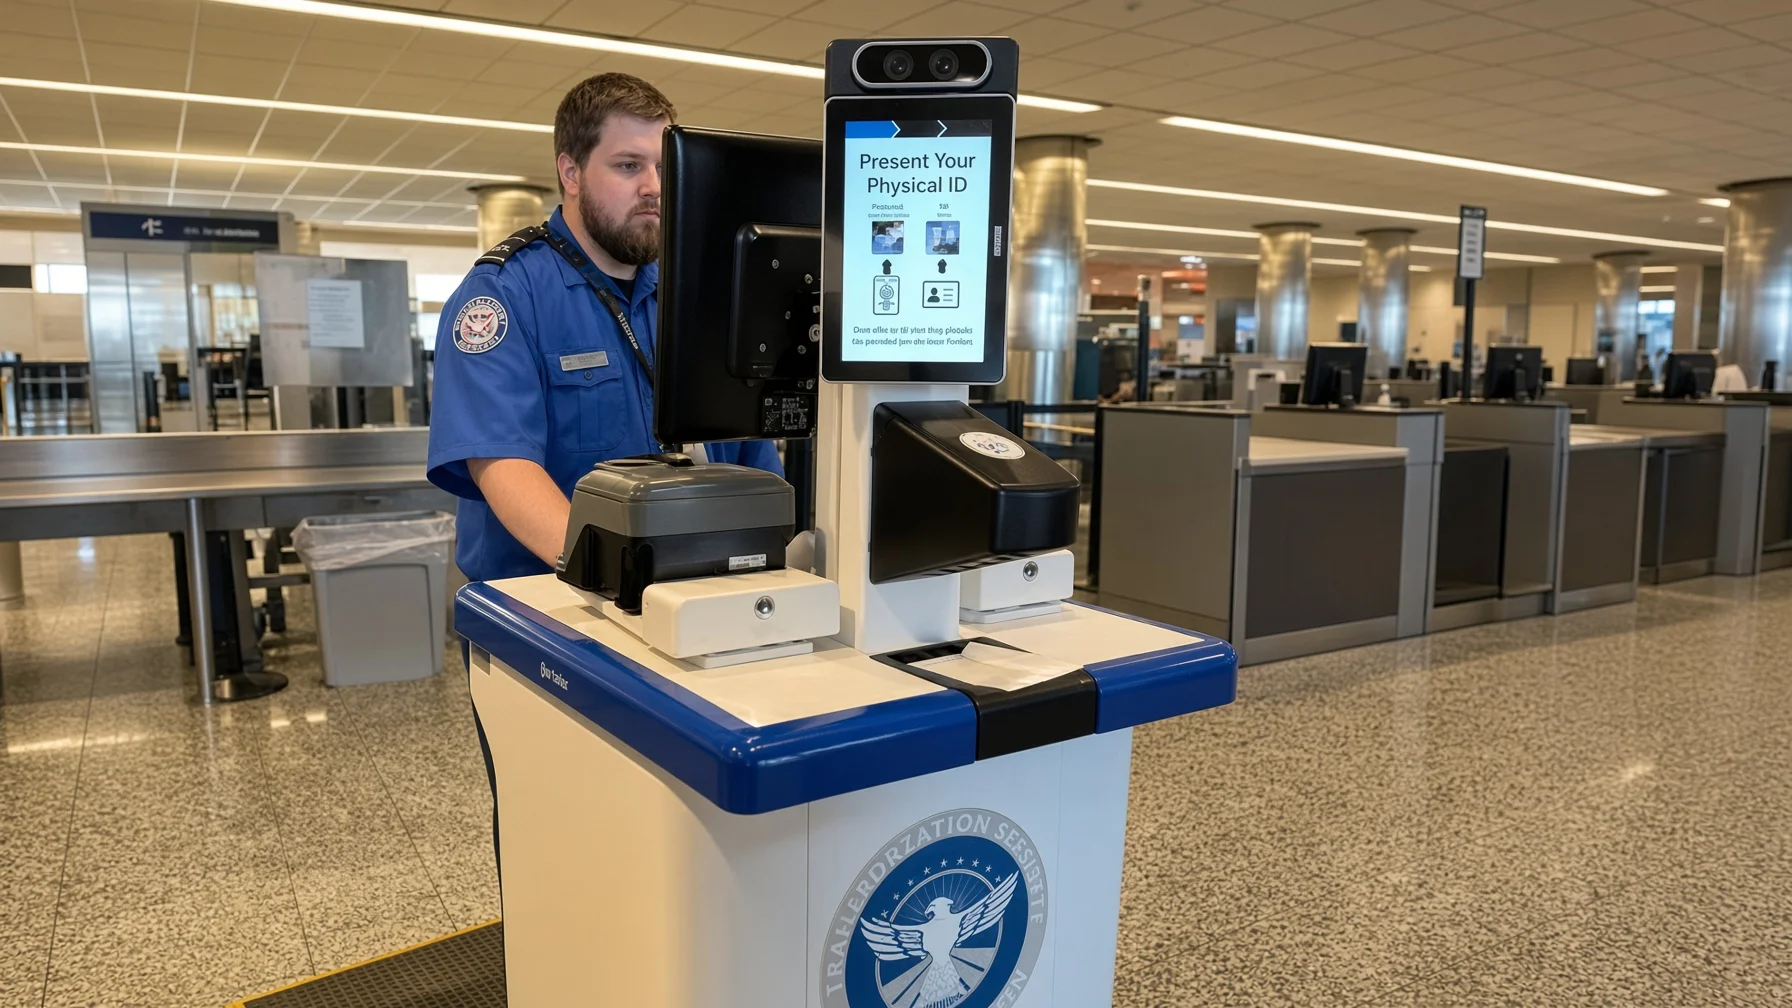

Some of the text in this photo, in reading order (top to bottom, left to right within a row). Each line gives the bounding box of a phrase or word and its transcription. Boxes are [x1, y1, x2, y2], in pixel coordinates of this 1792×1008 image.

[860, 152, 976, 169] Present Your
[867, 176, 968, 198] Physical ID
